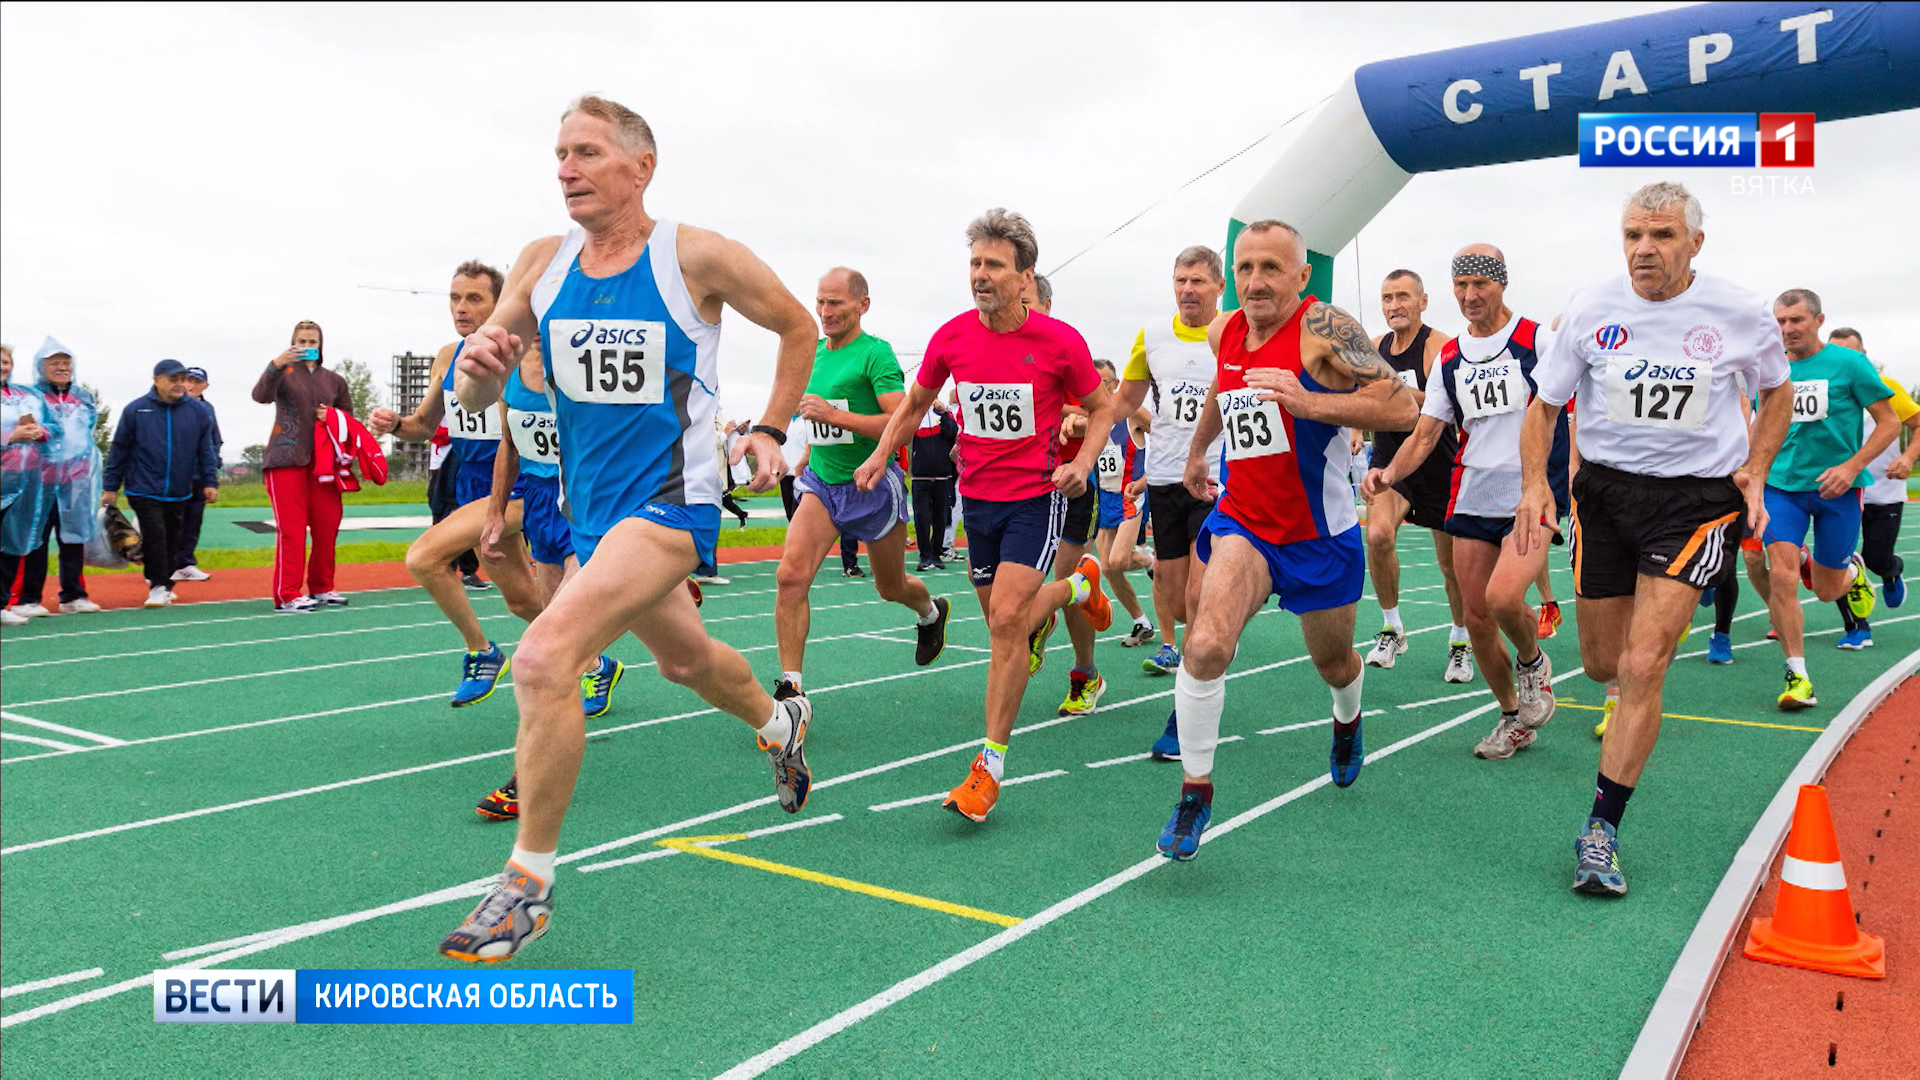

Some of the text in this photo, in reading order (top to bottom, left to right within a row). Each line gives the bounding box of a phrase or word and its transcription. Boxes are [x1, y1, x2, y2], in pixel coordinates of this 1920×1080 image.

[1442, 9, 1834, 125] СТАРТ
[578, 349, 645, 393] 155
[1173, 397, 1205, 422] 13
[1470, 379, 1509, 410] 141
[1629, 383, 1694, 420] 127
[1794, 395, 1818, 416] 40
[455, 409, 487, 433] 151
[974, 403, 1023, 432] 136
[1226, 411, 1272, 451] 153
[1099, 456, 1117, 472] 38
